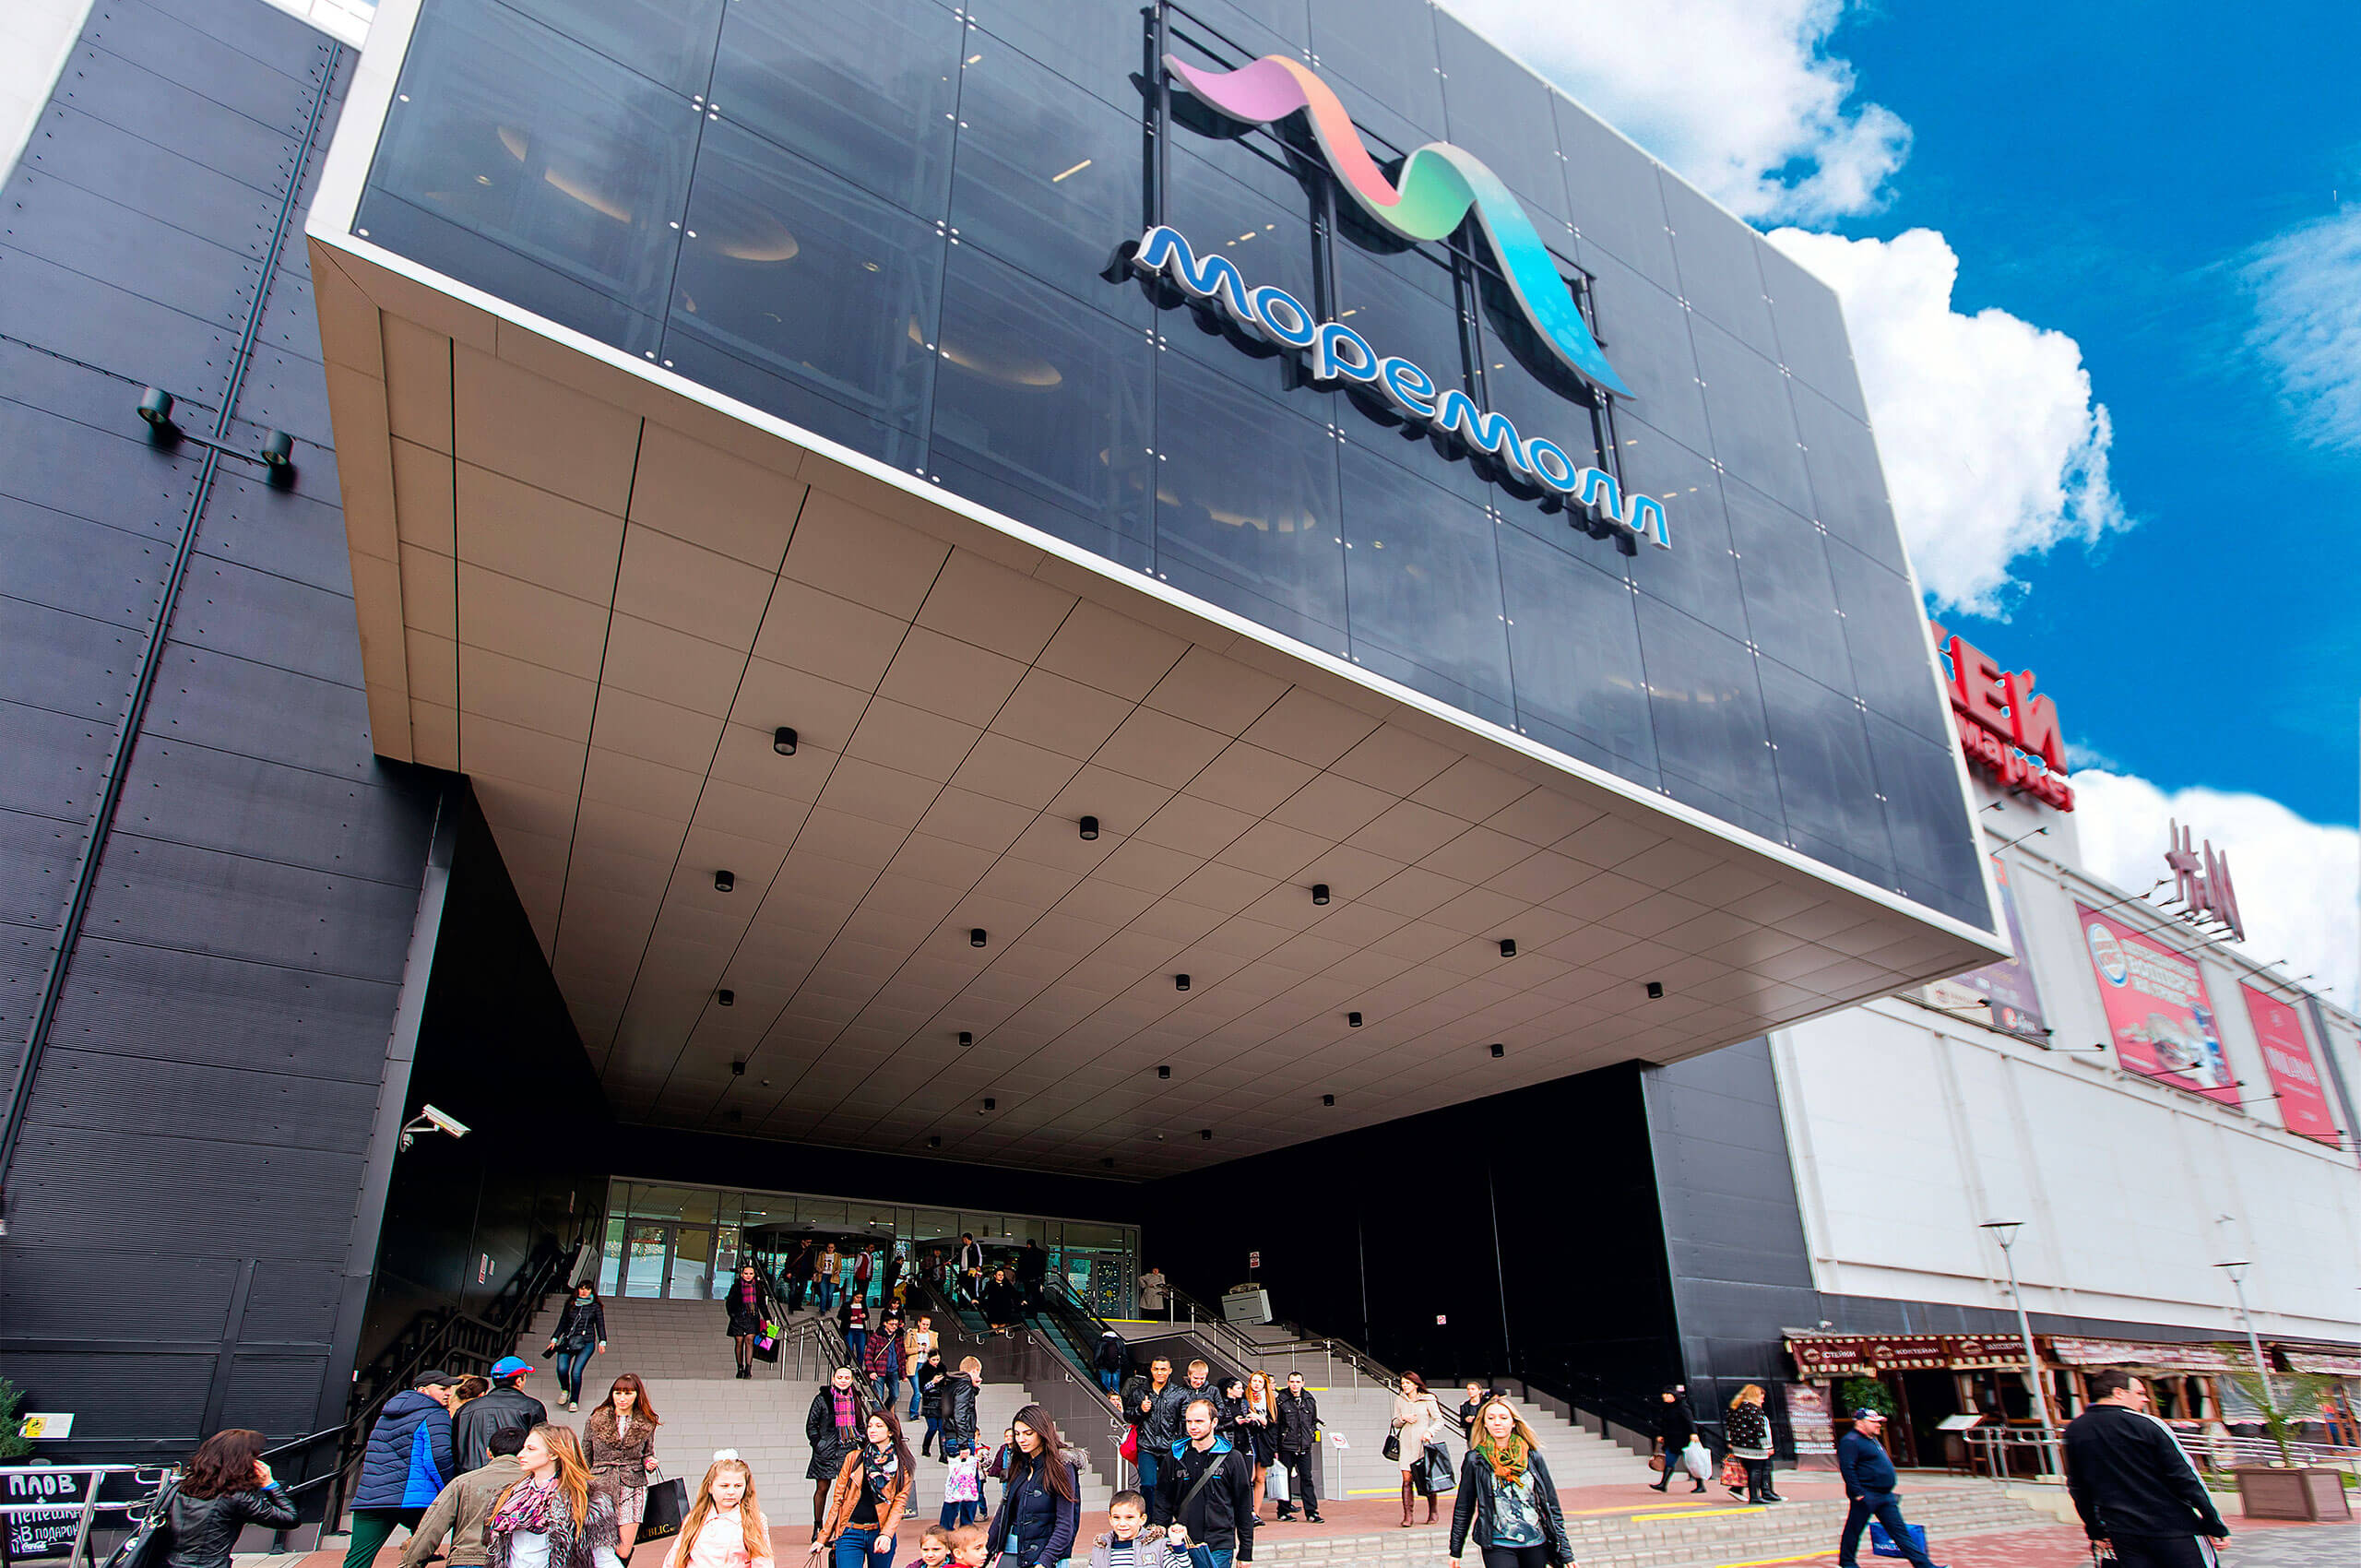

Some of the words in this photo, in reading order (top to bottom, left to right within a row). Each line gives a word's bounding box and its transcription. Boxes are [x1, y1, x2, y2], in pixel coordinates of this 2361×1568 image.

[1821, 1349, 1857, 1359] СТЕЙКИ
[1895, 1347, 1940, 1355] КОКТЕЙЛИ
[9, 1474, 77, 1496] ПЛОВ
